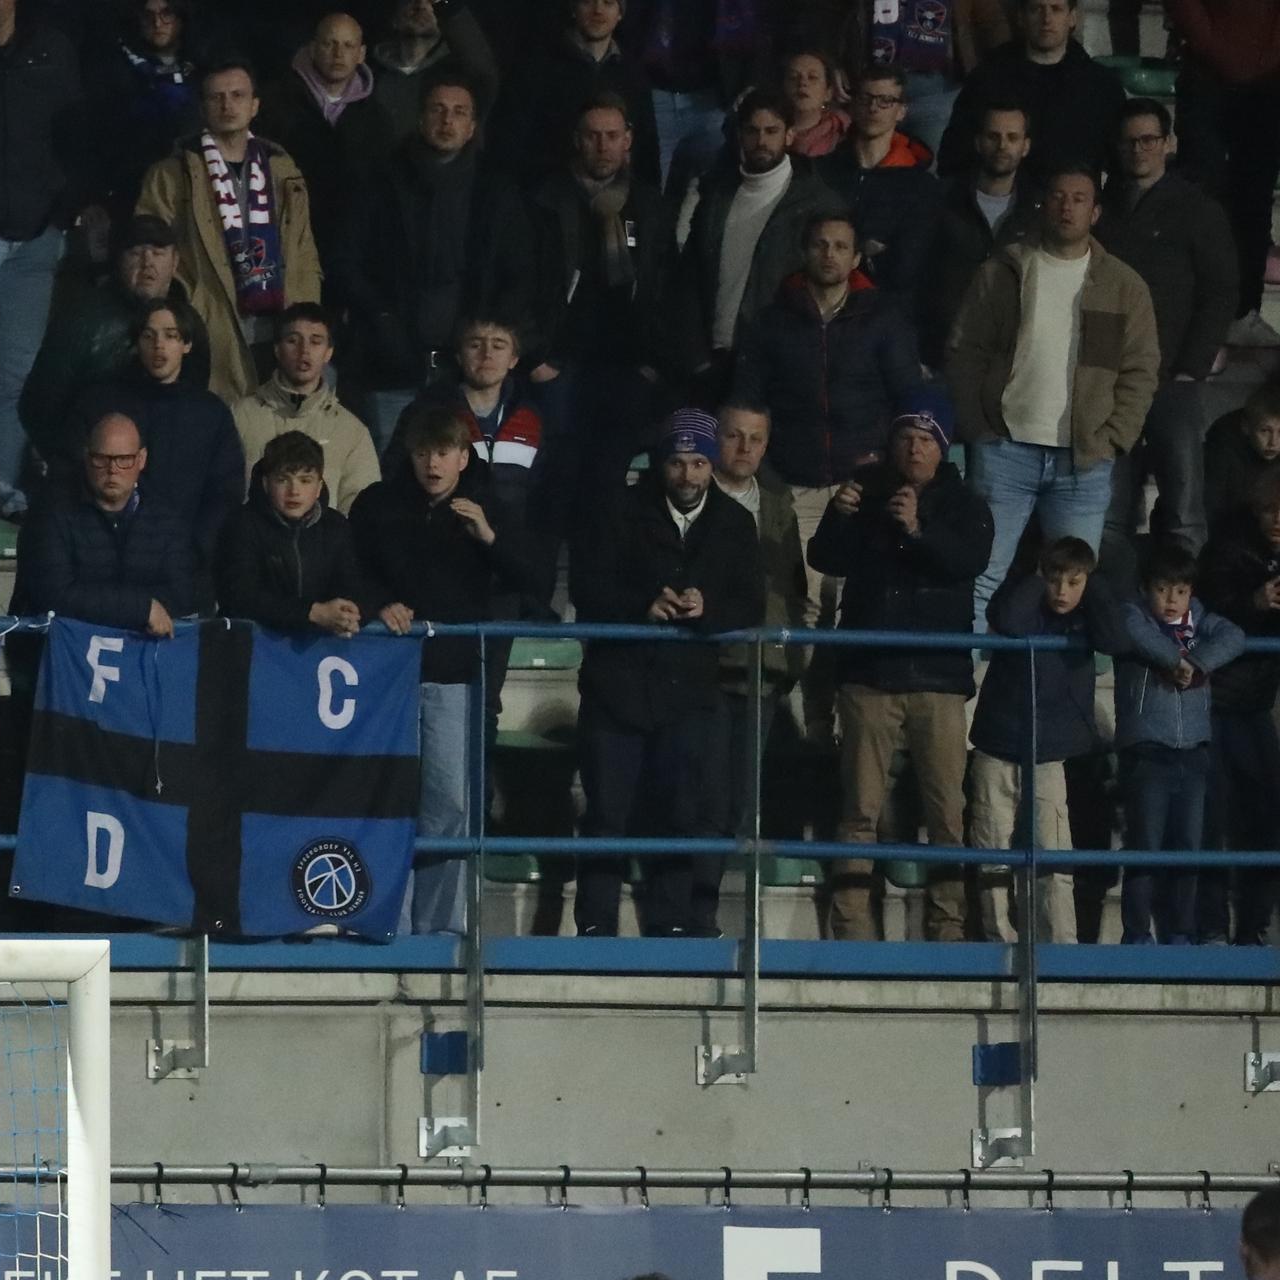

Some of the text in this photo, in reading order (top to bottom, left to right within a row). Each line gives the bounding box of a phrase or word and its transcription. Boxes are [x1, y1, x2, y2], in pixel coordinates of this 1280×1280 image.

[86, 634, 360, 730] F C
[83, 810, 126, 890] D
